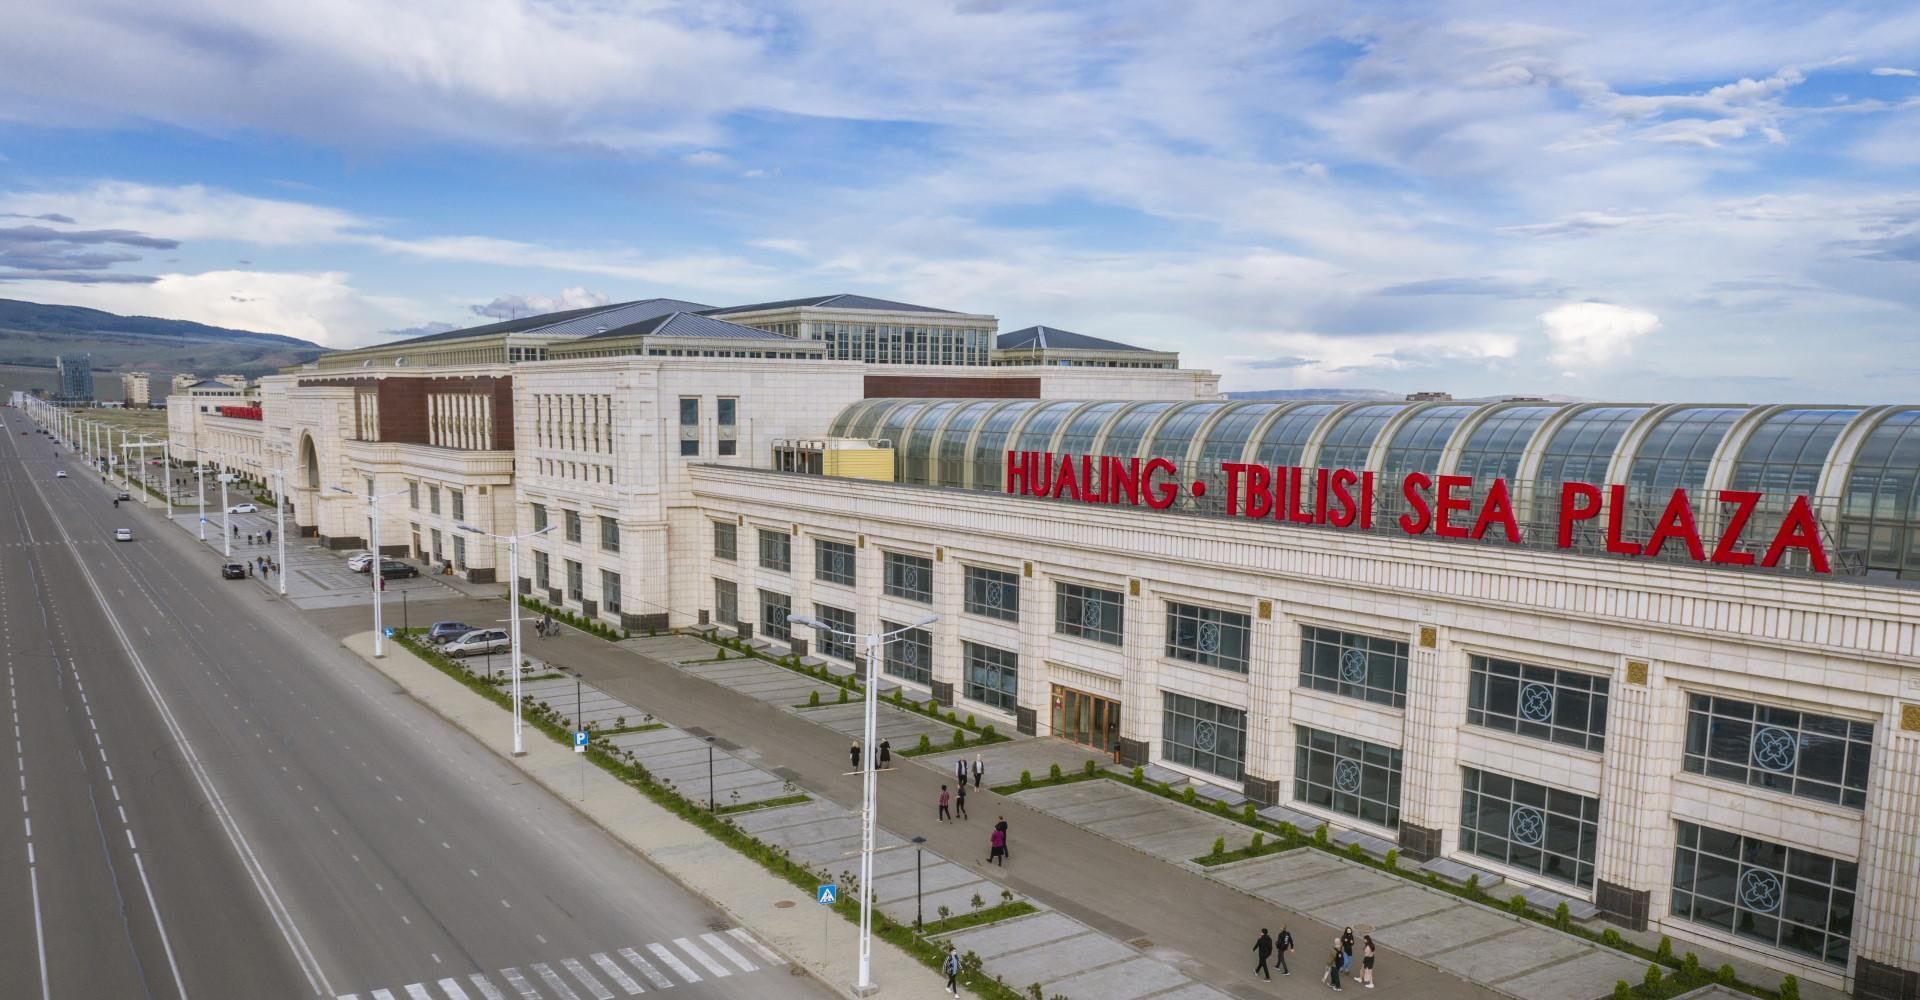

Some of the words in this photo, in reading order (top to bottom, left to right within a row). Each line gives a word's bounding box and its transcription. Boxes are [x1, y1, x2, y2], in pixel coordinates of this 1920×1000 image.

[1006, 450, 1178, 510] HUALING
[1221, 463, 1374, 530] TBILISI
[1399, 472, 1522, 544] SEA
[1557, 482, 1832, 574] PLAZA
[576, 733, 586, 745] P
